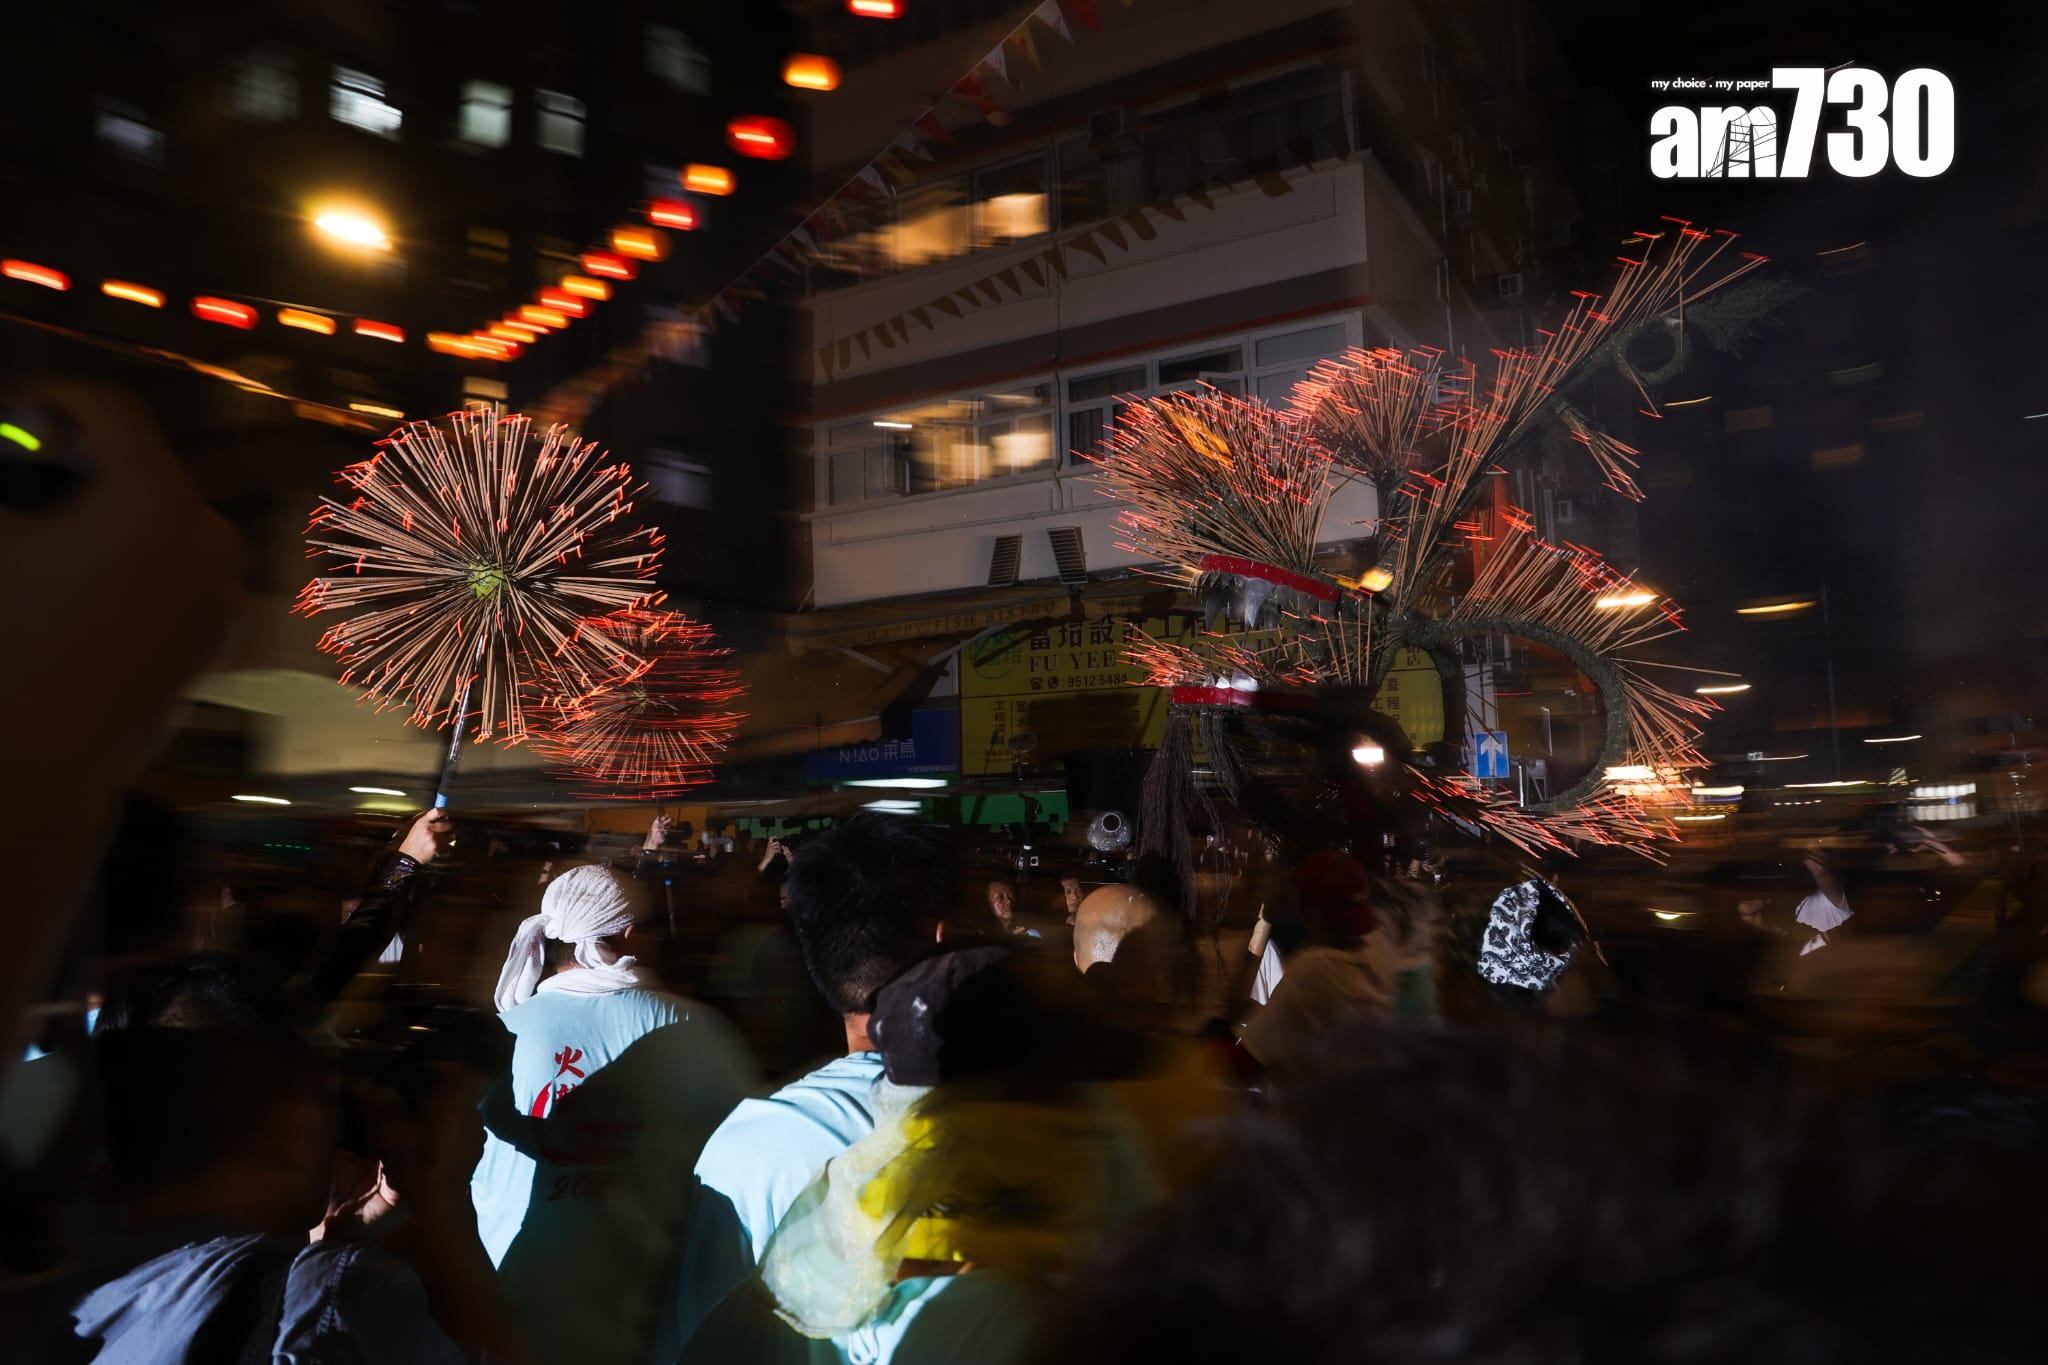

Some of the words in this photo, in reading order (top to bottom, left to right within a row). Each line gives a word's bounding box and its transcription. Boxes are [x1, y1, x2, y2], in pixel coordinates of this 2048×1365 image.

[934, 614, 975, 631] FISH
[1029, 655, 1057, 673] FU
[1067, 674, 1096, 687] 9512
[1100, 672, 1128, 685] 5484
